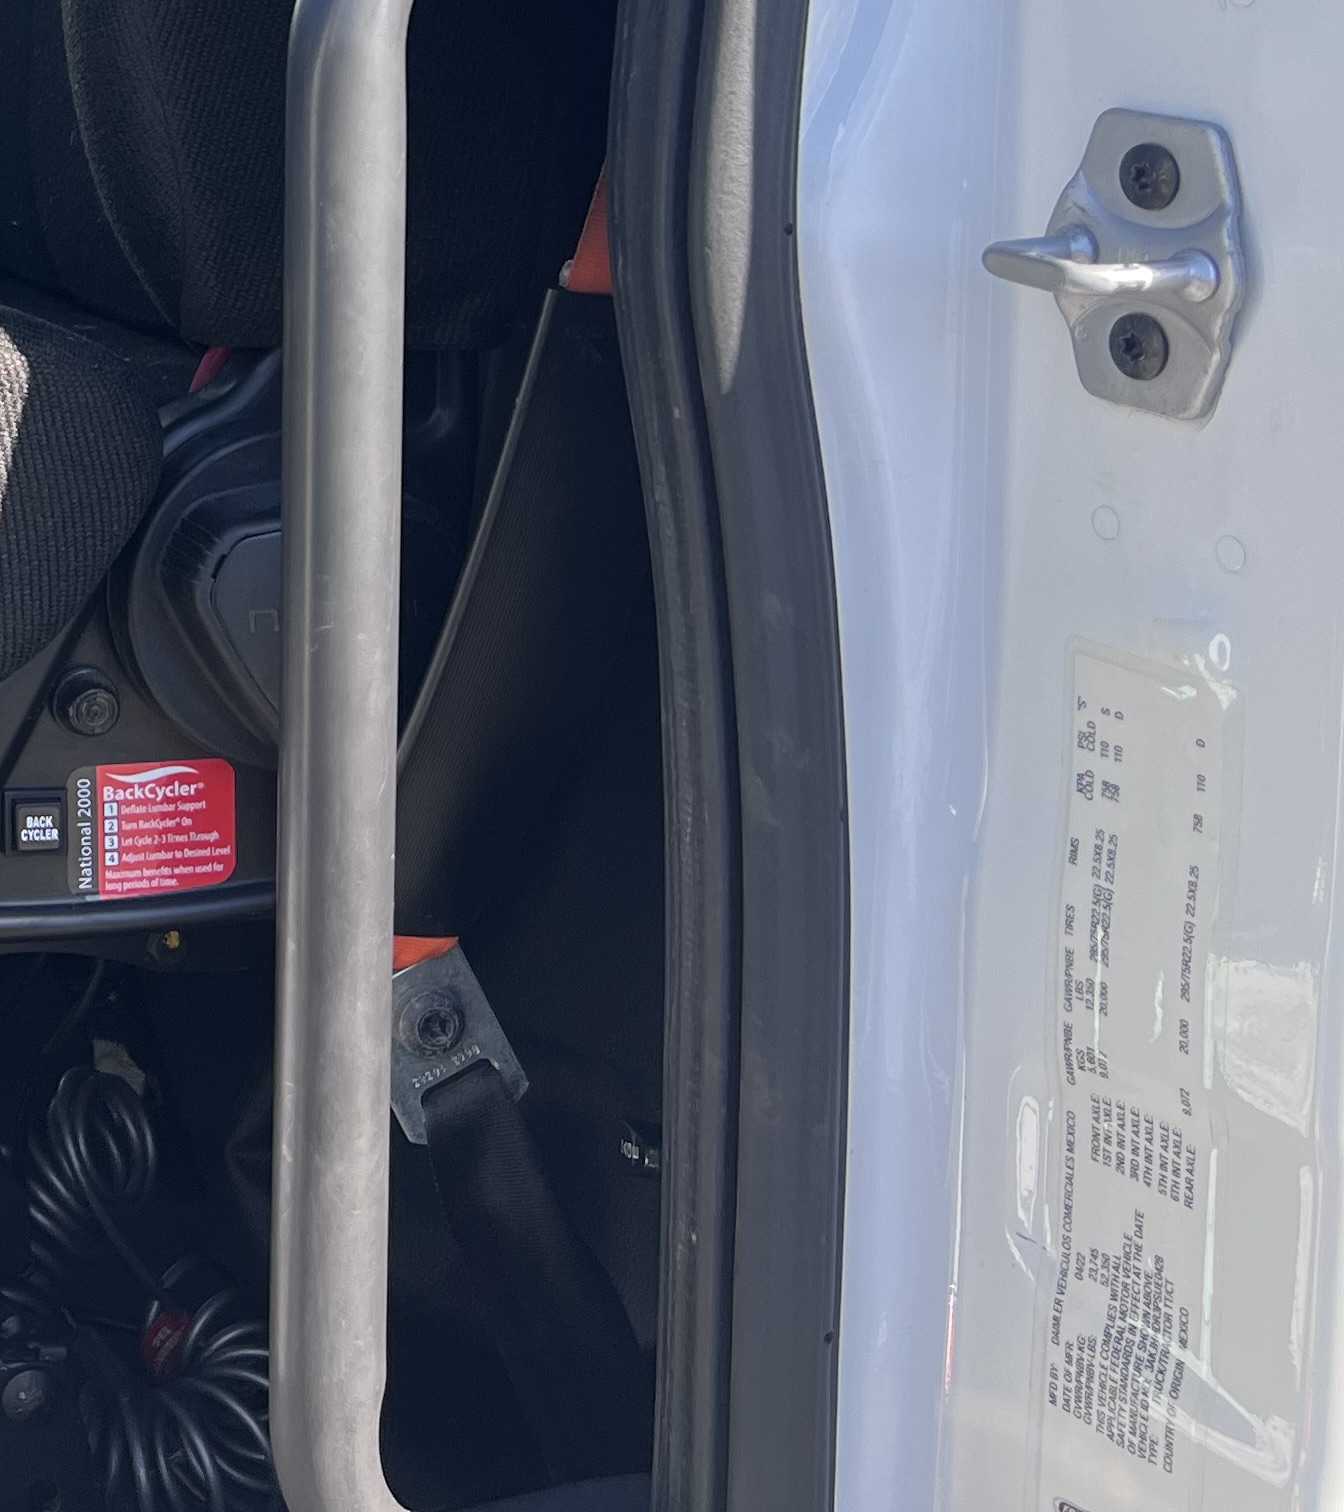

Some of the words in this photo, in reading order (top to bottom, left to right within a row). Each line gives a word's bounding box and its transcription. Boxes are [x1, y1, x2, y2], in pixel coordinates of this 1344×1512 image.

[1195, 738, 1206, 749] D
[1196, 774, 1206, 793] 110
[77, 779, 91, 818] 2000
[121, 804, 147, 815] Deflate
[148, 803, 176, 813] Lumbar
[177, 800, 206, 812] Support
[21, 829, 59, 841] CYCLER
[26, 816, 53, 828] BACK
[121, 821, 137, 831] Turn
[181, 817, 193, 826] On
[1193, 813, 1204, 834] 758
[121, 837, 132, 847] Let
[132, 836, 152, 847] Cycle
[153, 834, 166, 844] 2-3
[167, 834, 188, 843] Times
[189, 831, 220, 843] Through
[1068, 837, 1080, 865] RIMS
[79, 823, 92, 889] National
[122, 852, 146, 863] Adjust
[147, 850, 174, 861] Lumbar
[175, 850, 183, 859] to
[184, 847, 211, 859] Desired
[211, 846, 231, 856] Level
[105, 868, 142, 880] Maximum
[143, 865, 173, 877] benefits
[173, 865, 193, 874] when
[194, 862, 212, 873] used
[212, 862, 224, 873] for
[105, 881, 122, 892] long
[123, 880, 150, 891] periods
[150, 879, 158, 888] of
[1185, 865, 1200, 918] 22.5X8.25
[1064, 904, 1075, 936] TIRES
[1180, 920, 1194, 1003] 295/75R22.5(G)
[1063, 946, 1074, 1013] GAWR/PNBE
[1074, 979, 1085, 1001] LBS
[1178, 1018, 1190, 1055] 20,000
[1063, 1020, 1076, 1086] GAWR/PNBE
[1075, 1048, 1087, 1072] KGS
[1180, 1088, 1193, 1117] 9,072
[1066, 1111, 1076, 1154] MEXICO
[1062, 1155, 1074, 1233] COMERCIALES
[1183, 1176, 1194, 1210] REAR
[1056, 1234, 1072, 1296] VEHICULOS
[1074, 1252, 1086, 1281] 04/22
[1088, 1247, 1099, 1282] 23,745
[1099, 1253, 1111, 1288] 52,350
[1050, 1298, 1063, 1346] DAIMLER
[1151, 1312, 1173, 1405] TRUCK/TRACTOR
[1163, 1277, 1175, 1310] TT/CT
[1064, 1368, 1073, 1384] OF
[1048, 1382, 1058, 1407] MFD
[1062, 1386, 1072, 1413] DATE
[1139, 1398, 1149, 1411] ID
